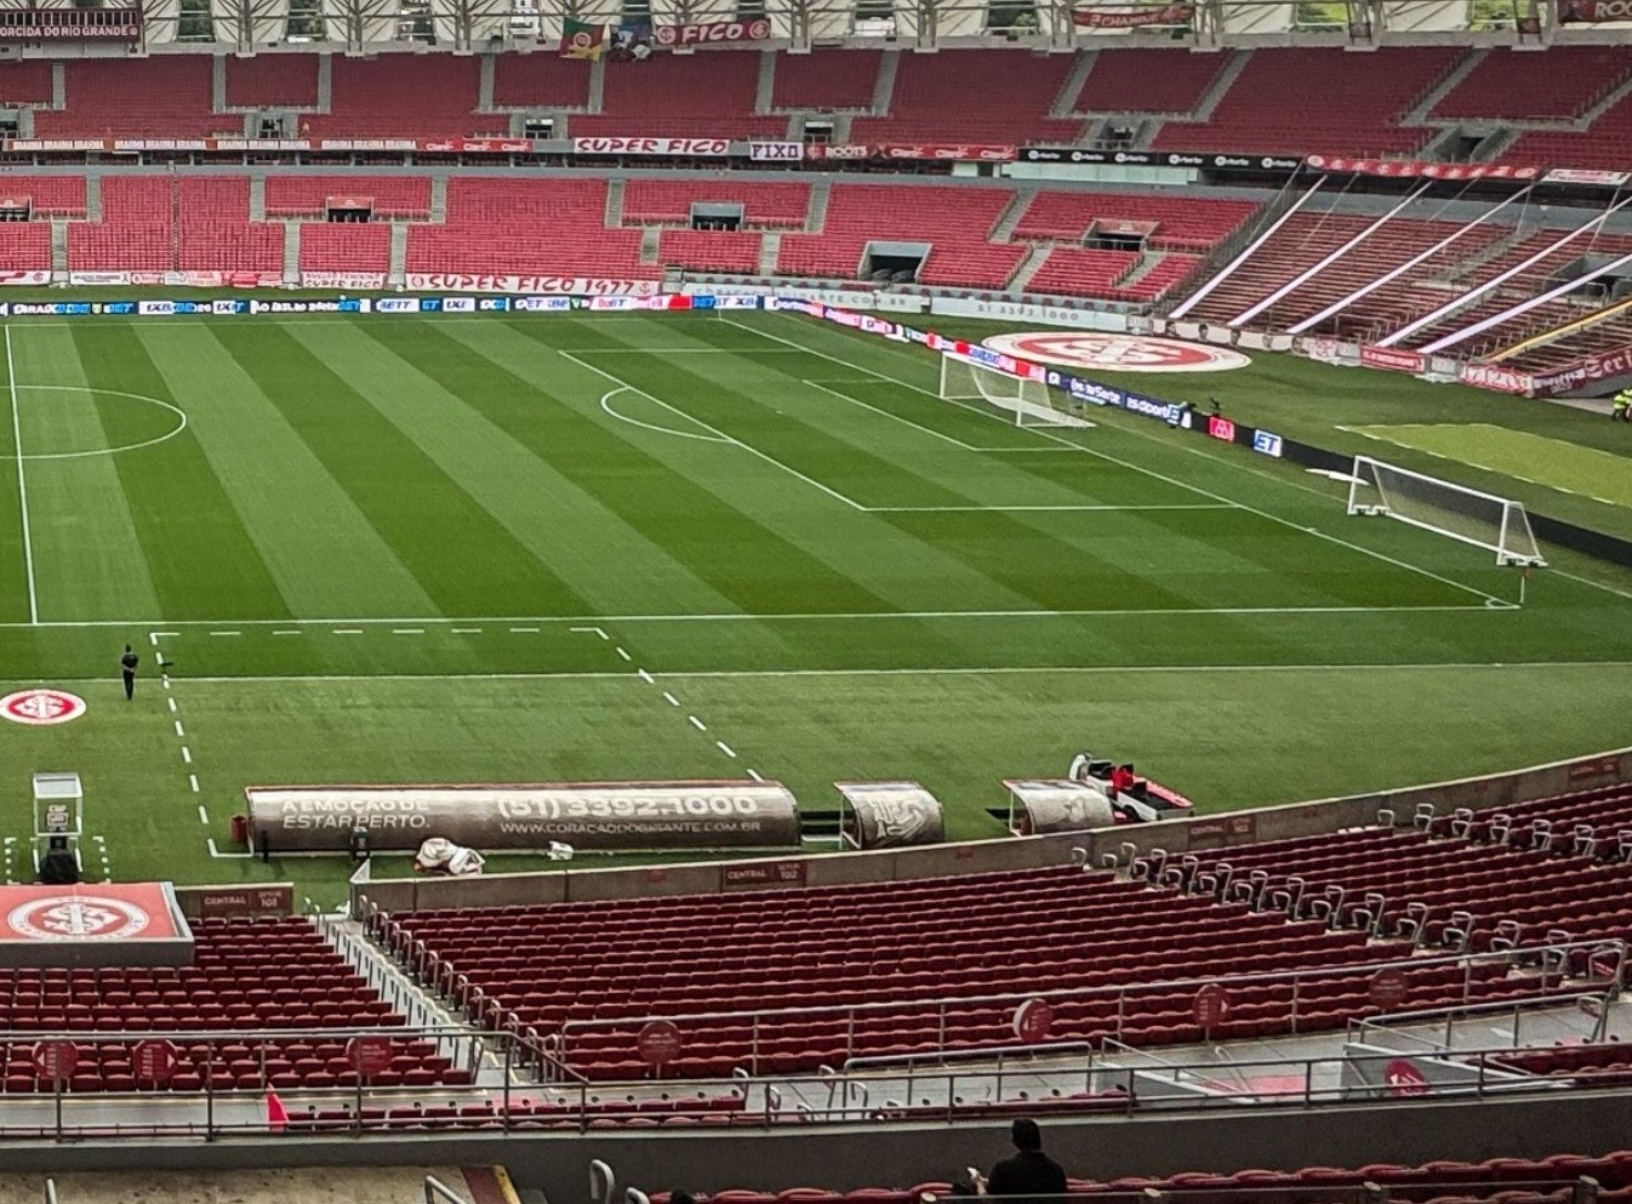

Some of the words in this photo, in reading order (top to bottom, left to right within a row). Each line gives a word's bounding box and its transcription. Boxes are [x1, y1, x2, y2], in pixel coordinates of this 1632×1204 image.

[44, 27, 60, 36] DO
[61, 27, 80, 36] RIO
[82, 26, 128, 36] GRANDE
[682, 24, 744, 43] FICO
[577, 139, 659, 153] SUPER
[668, 139, 728, 153] FICO
[429, 275, 508, 289] SUPER
[518, 278, 576, 291] FICO
[585, 280, 635, 294] 1977
[282, 800, 298, 812] A
[400, 800, 430, 811] DE
[496, 796, 560, 819] (51)
[567, 796, 758, 817] 3392.1000
[282, 814, 352, 829] ESTAR
[356, 814, 431, 829] PERTO.
[728, 868, 767, 879] CENTRAL
[204, 896, 247, 905] CENTRAL
